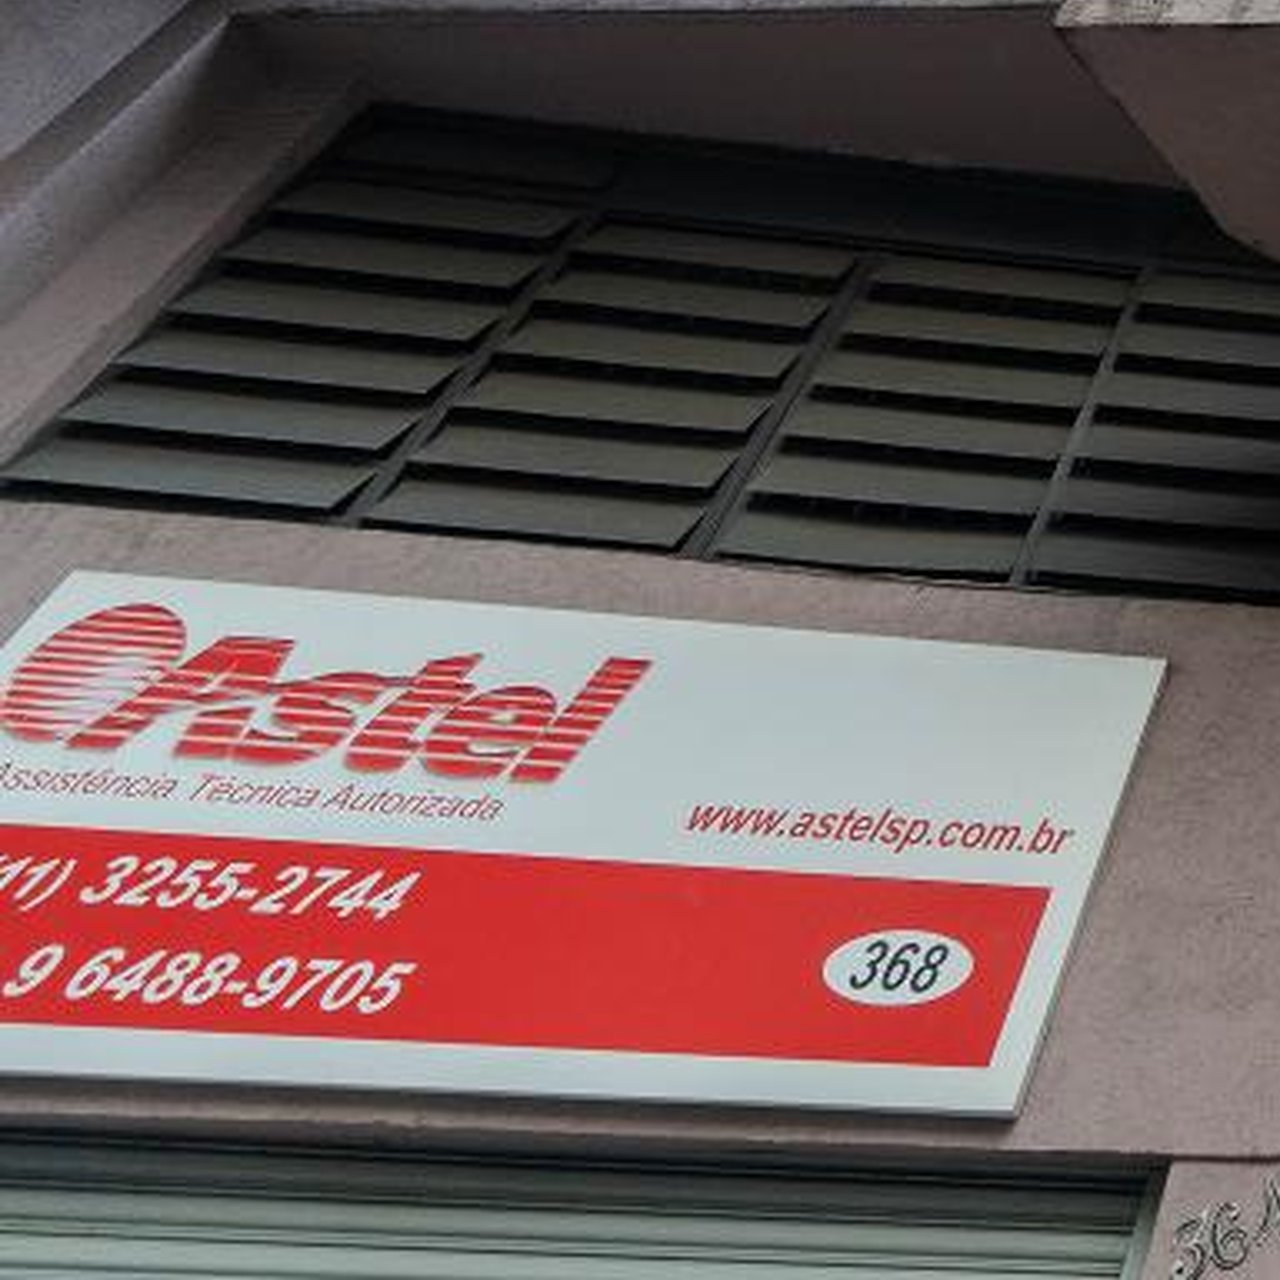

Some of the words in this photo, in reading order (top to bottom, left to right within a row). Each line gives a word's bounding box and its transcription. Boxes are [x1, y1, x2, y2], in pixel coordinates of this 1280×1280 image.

[189, 773, 320, 808] Técnica
[322, 783, 504, 821] Autorizada
[684, 803, 1076, 854] www.astelsp.com.br
[0, 855, 78, 912] 11)
[80, 855, 422, 920] 3255-2744
[2, 943, 66, 998] 9
[64, 948, 417, 1015] 6488-9705
[849, 939, 951, 994] 368
